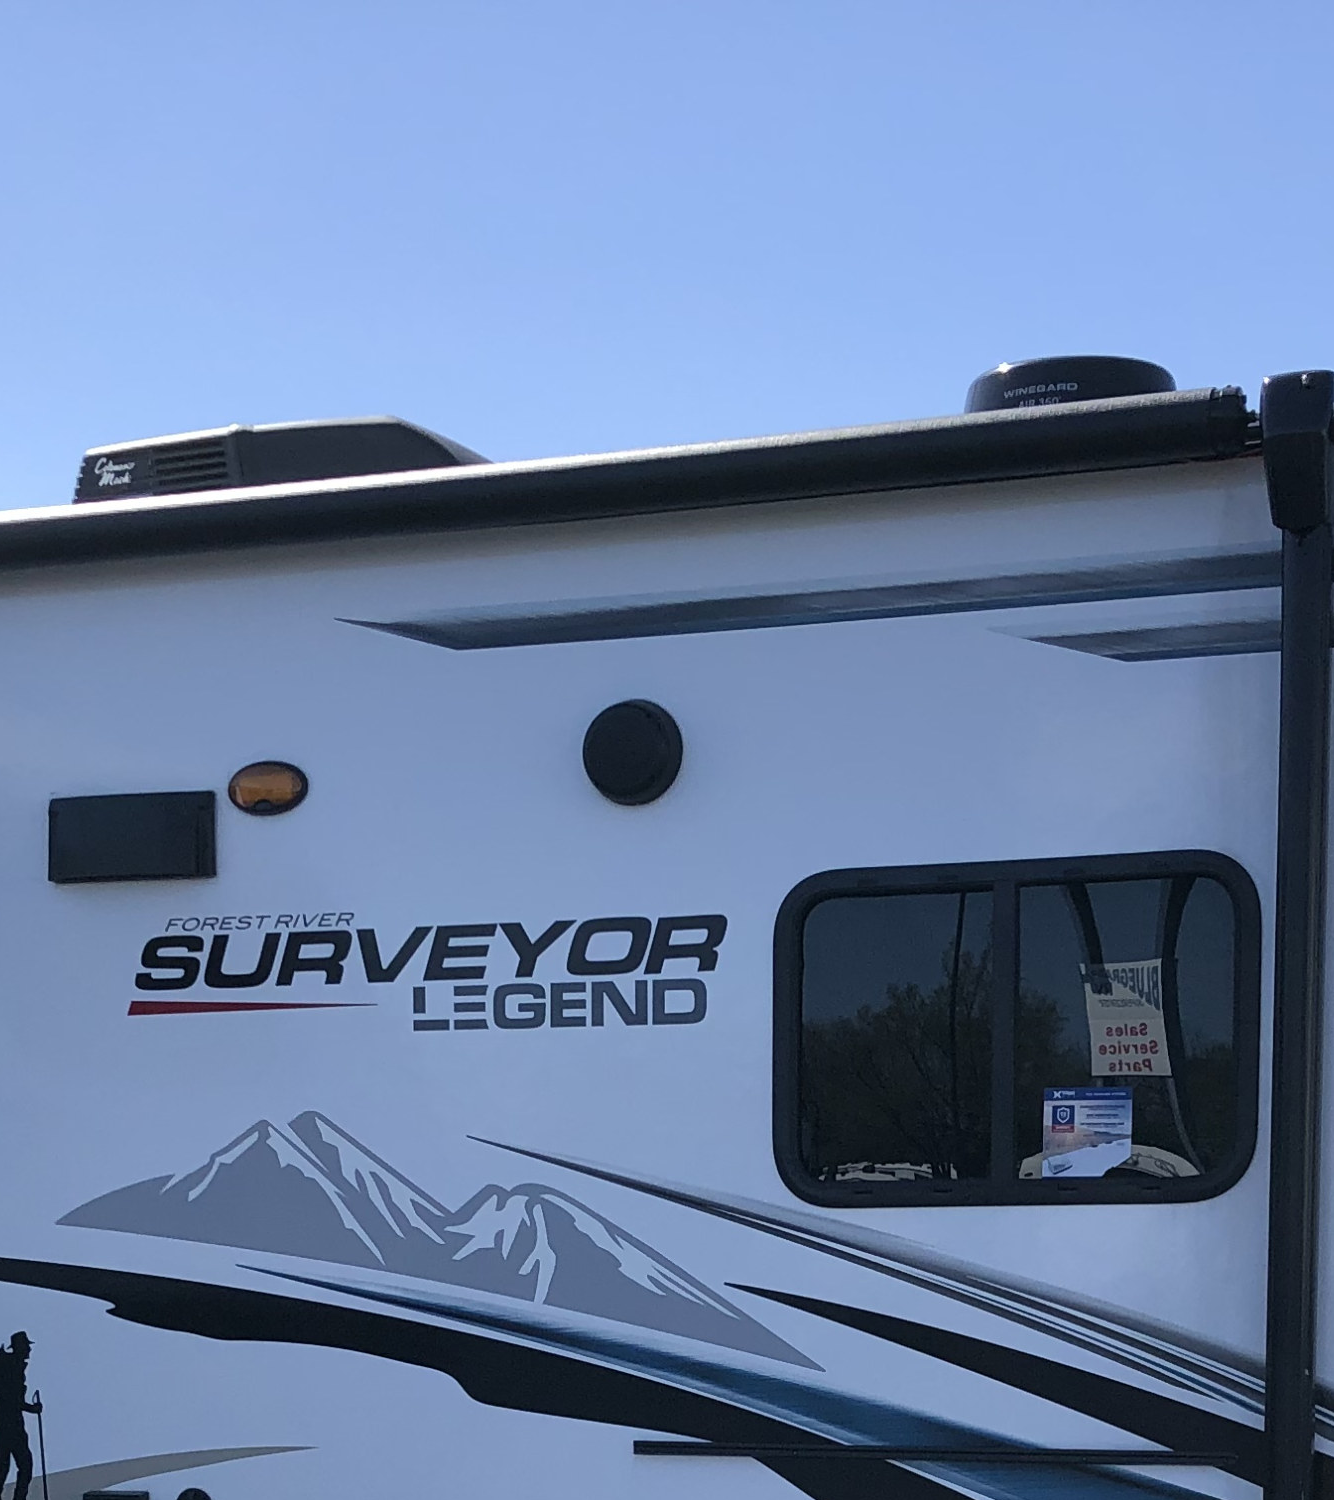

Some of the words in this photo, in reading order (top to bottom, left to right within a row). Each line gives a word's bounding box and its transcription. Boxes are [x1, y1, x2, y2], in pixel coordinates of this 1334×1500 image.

[1003, 382, 1079, 399] WINEGARD
[165, 915, 271, 933] FOREST
[274, 911, 355, 930] RIVER
[134, 914, 729, 991] SURVEYOR
[412, 978, 708, 1032] LEGEND
